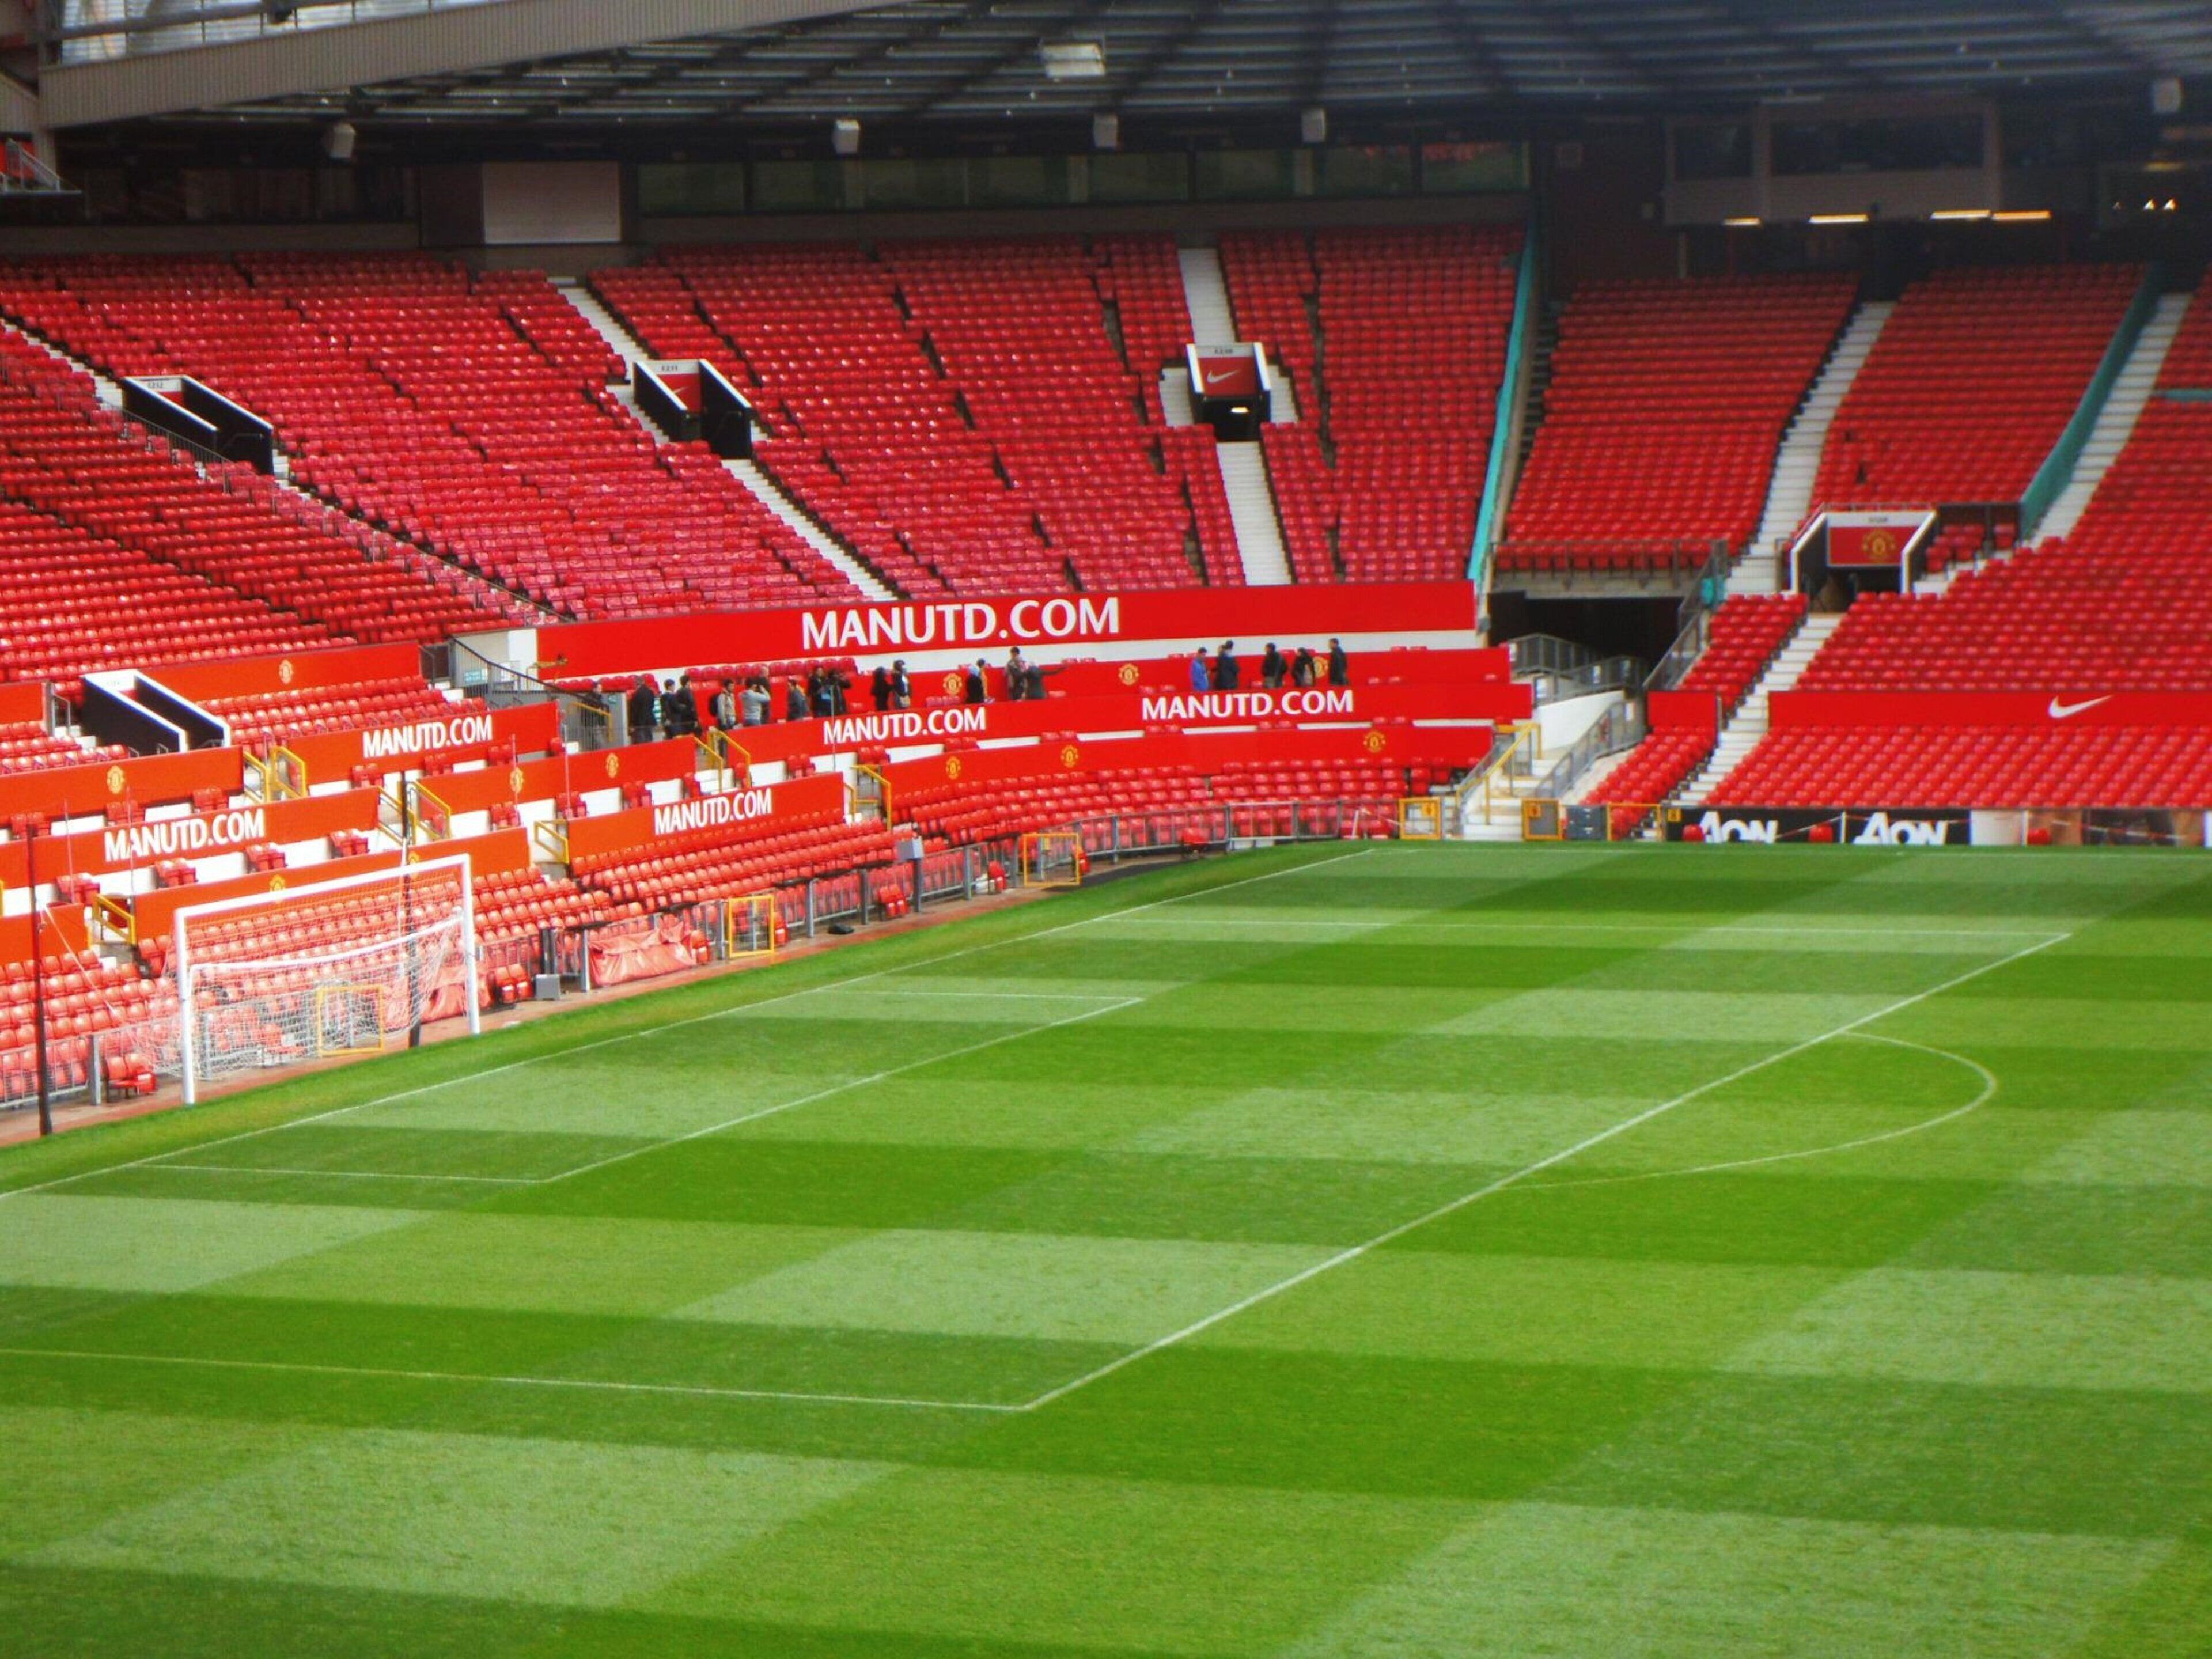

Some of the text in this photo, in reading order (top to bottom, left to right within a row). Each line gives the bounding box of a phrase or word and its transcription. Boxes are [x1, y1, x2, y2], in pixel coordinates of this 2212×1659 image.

[802, 597, 1119, 650] MANUTD.COM
[824, 707, 986, 745] MANUTD.COM
[1142, 690, 1353, 720] MANUTD.COM
[363, 715, 493, 759] MANUTD.COM
[654, 787, 772, 835] MANUTD.COM
[1853, 812, 1948, 844] AON
[104, 808, 266, 862] MANUTD.COM
